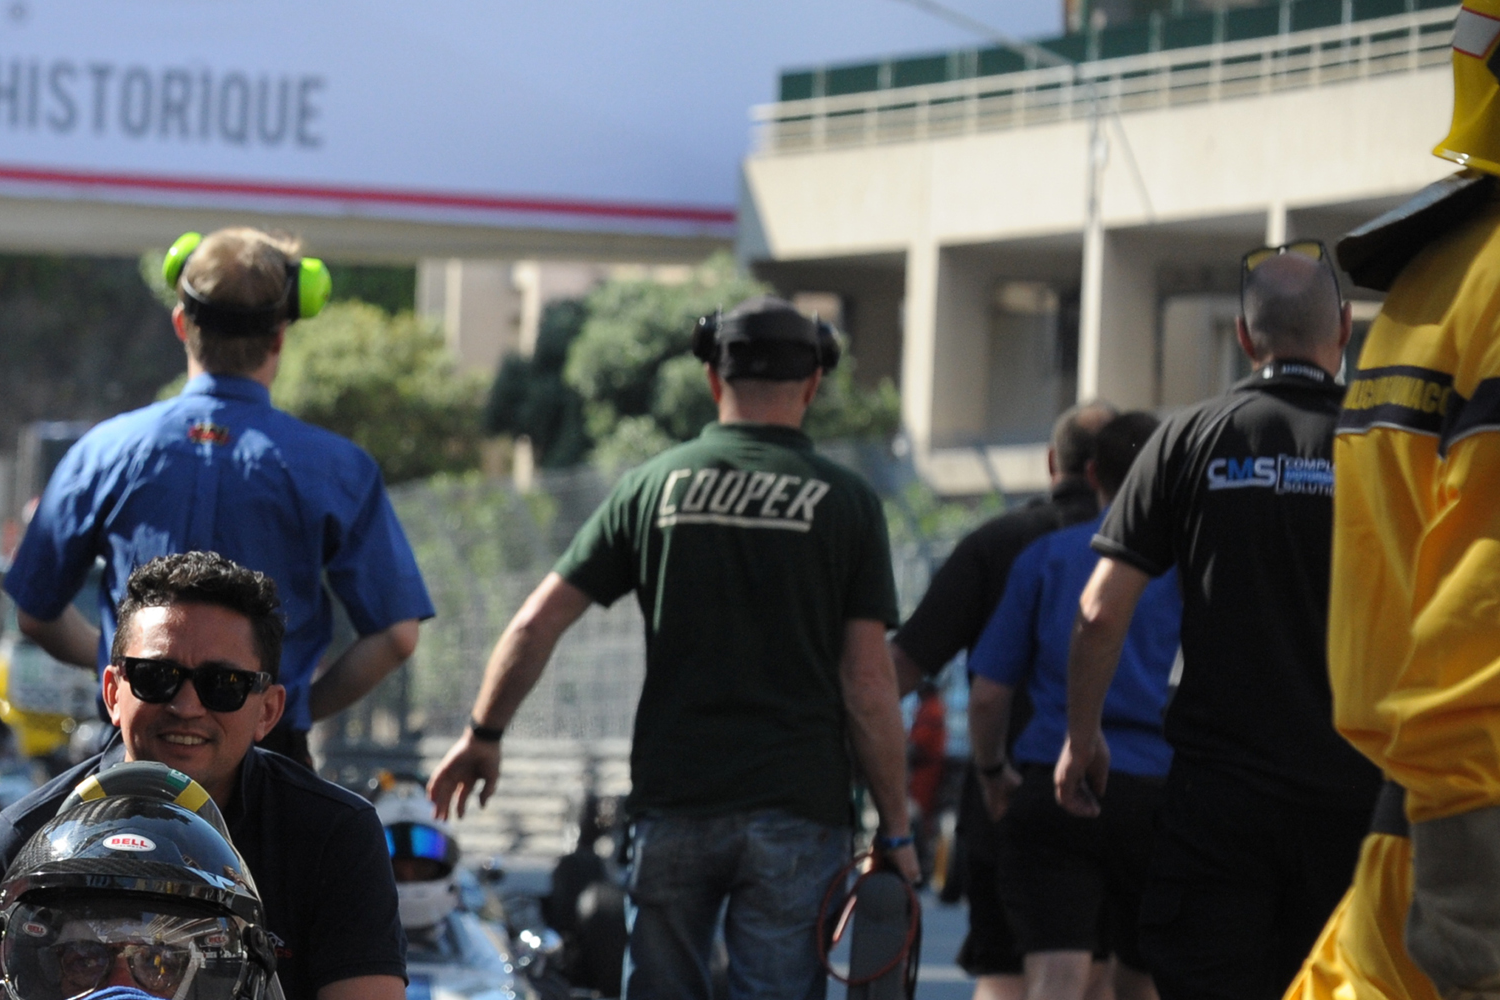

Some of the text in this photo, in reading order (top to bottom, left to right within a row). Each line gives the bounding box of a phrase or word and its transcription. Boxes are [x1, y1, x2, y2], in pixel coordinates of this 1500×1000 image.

[1207, 456, 1277, 488] CMS
[658, 468, 831, 522] COOPER
[111, 838, 148, 848] BELL
